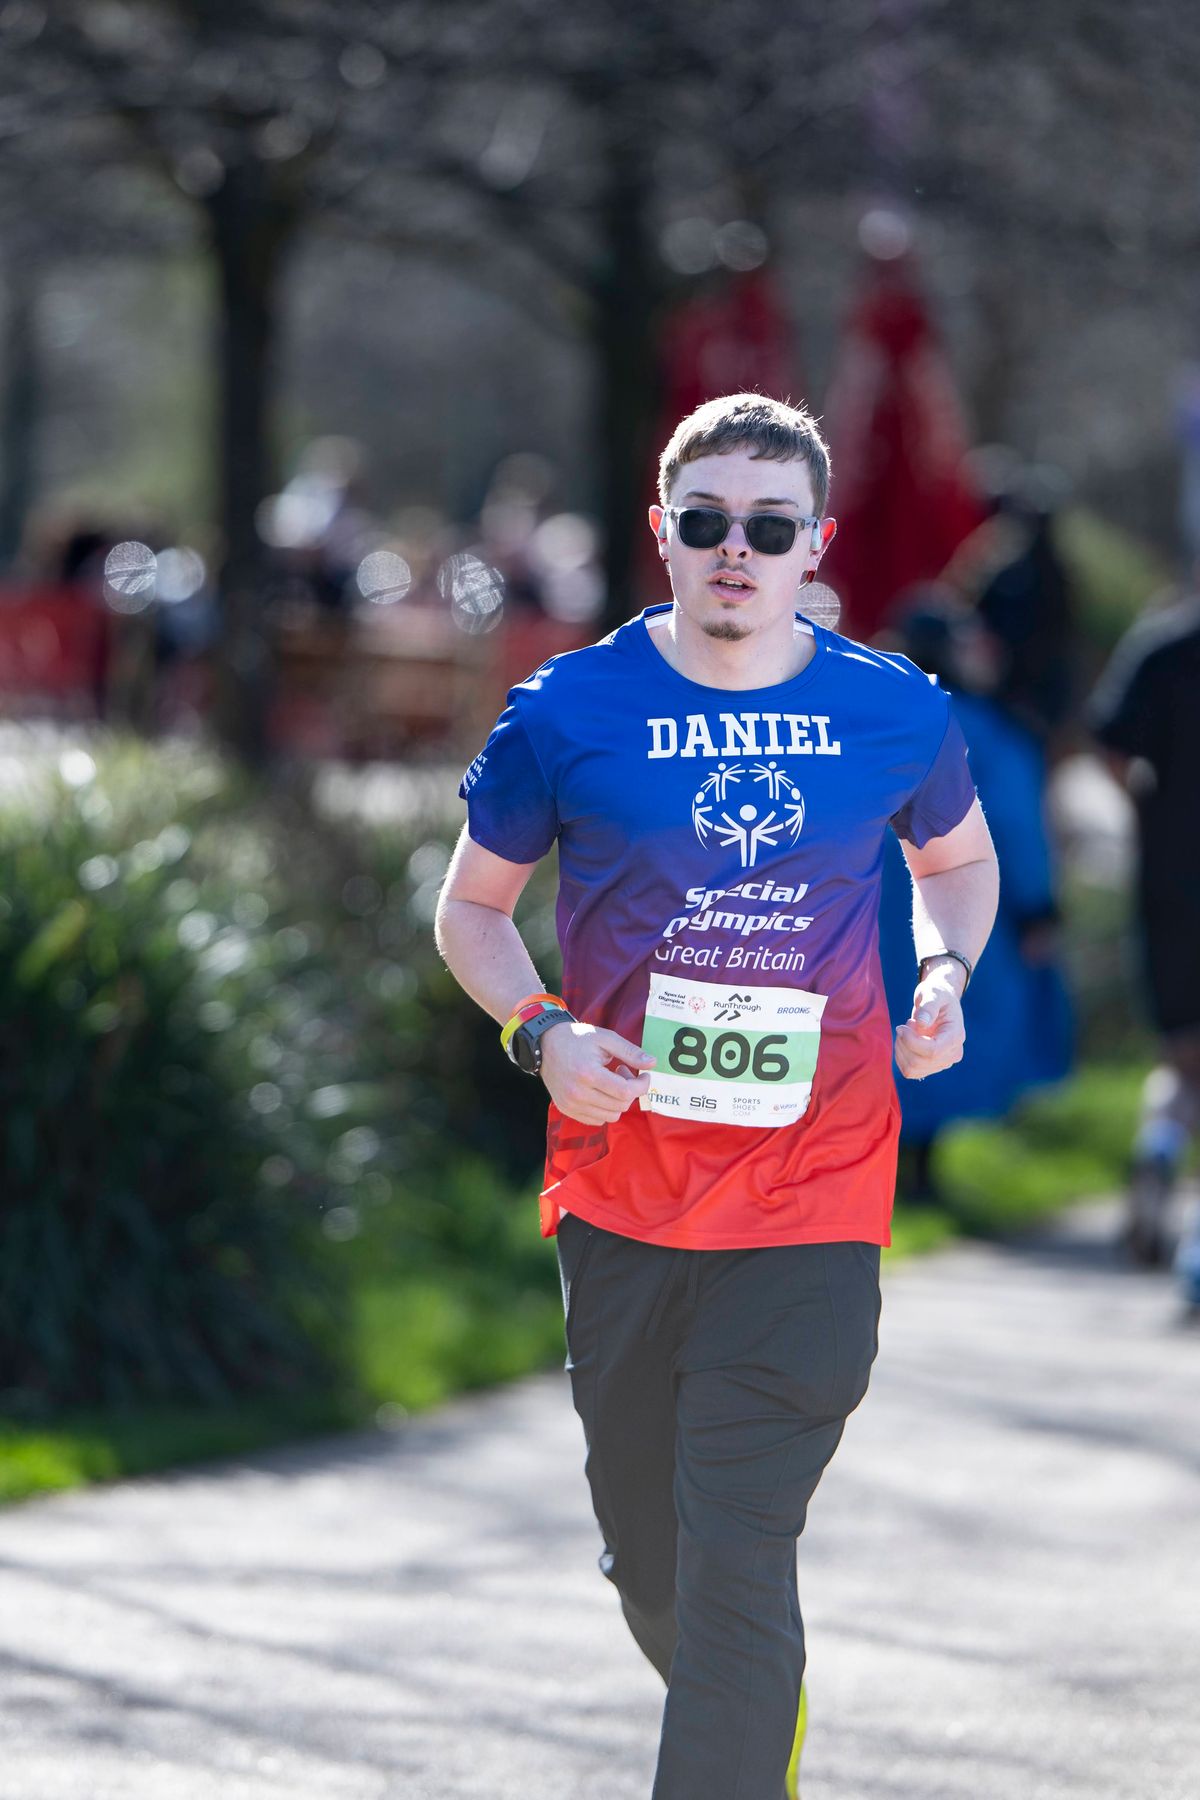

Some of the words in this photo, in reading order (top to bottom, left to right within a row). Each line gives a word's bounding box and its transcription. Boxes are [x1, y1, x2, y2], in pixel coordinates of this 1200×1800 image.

[647, 712, 841, 759] DANIEL
[685, 880, 809, 911] Special
[663, 910, 814, 937] Oympics
[655, 939, 722, 968] Great
[726, 945, 806, 971] Britain
[714, 1001, 761, 1012] RunThrough
[669, 1026, 790, 1081] 806
[732, 1103, 757, 1111] SHOES
